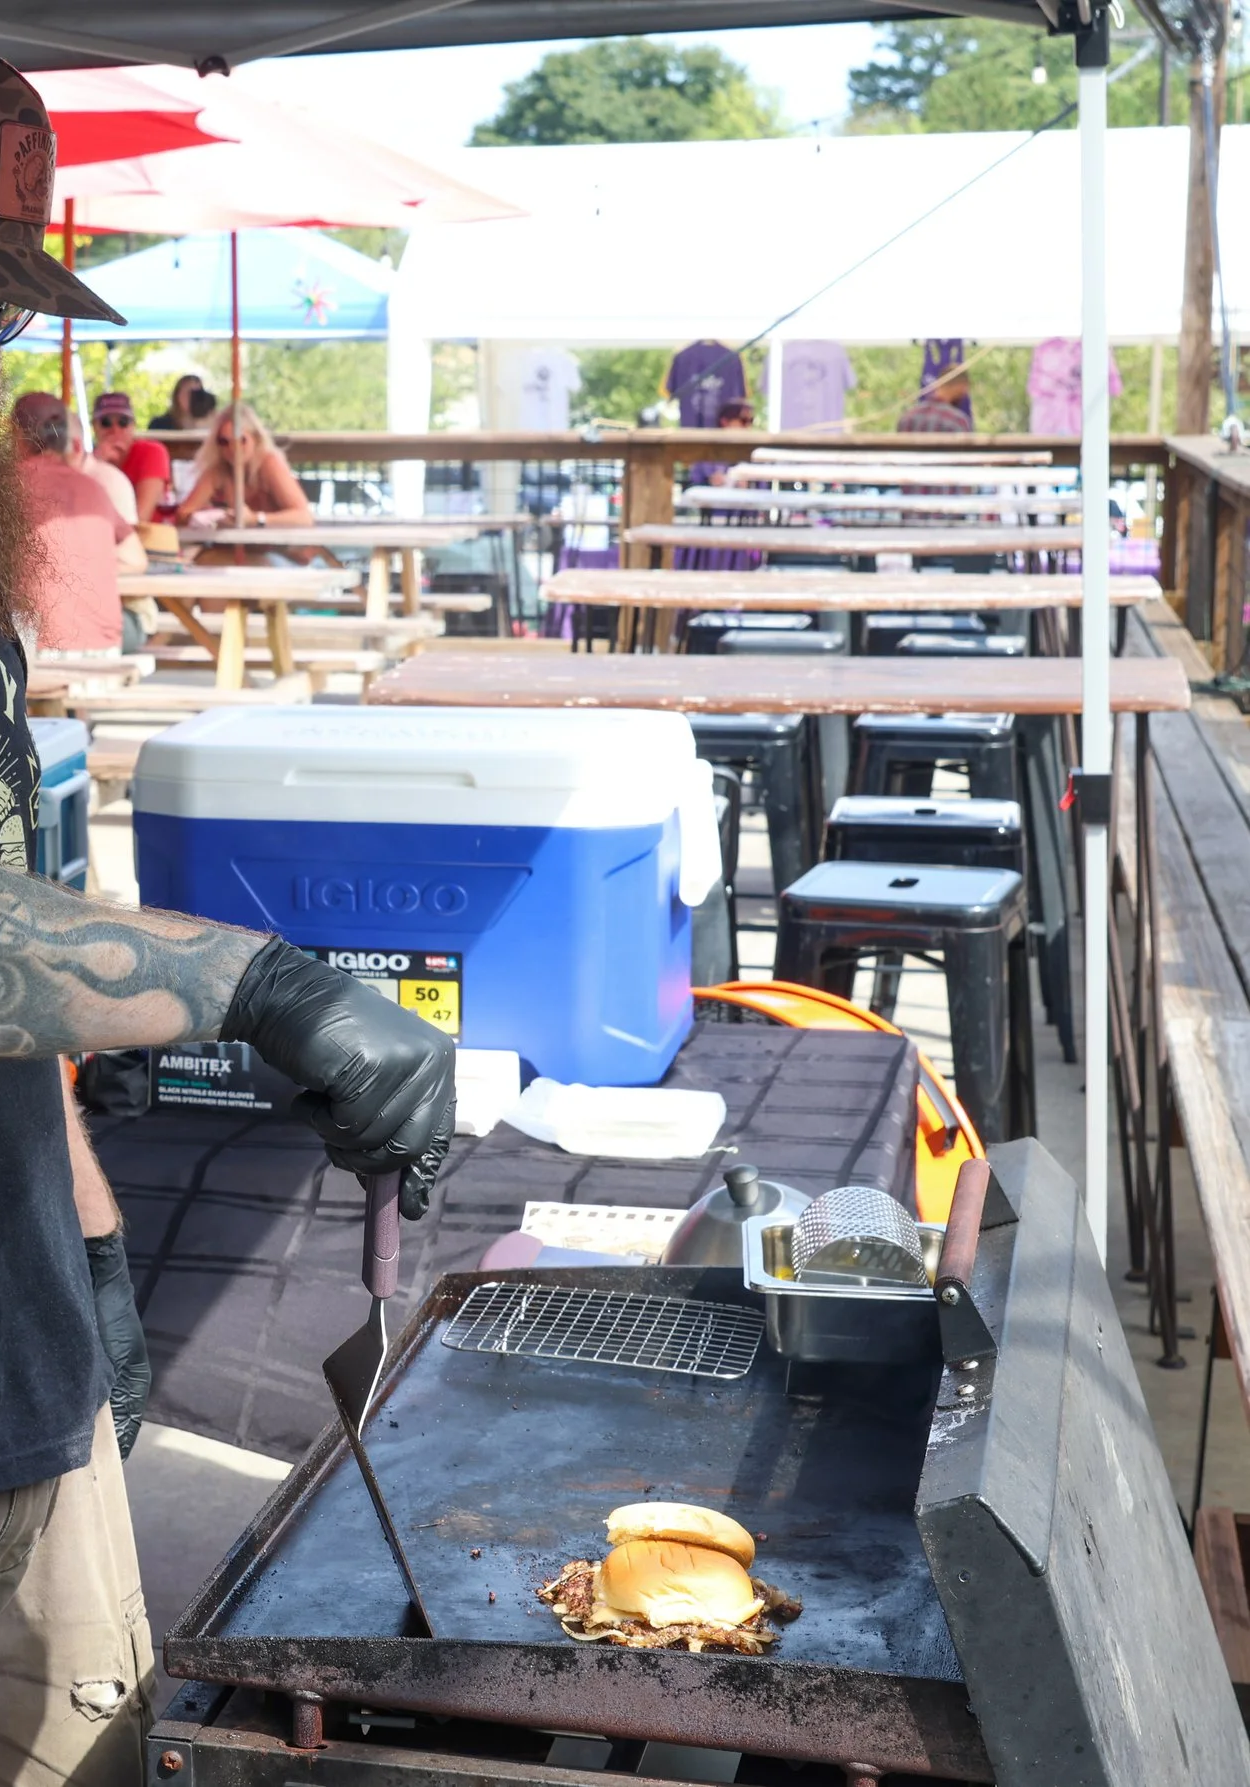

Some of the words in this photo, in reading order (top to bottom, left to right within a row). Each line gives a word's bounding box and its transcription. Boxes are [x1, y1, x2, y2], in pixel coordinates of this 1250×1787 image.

[292, 875, 469, 916] IGLOO
[328, 951, 411, 972] IGLOO
[415, 987, 440, 1002] 50
[433, 1010, 452, 1021] 47
[159, 1054, 232, 1073] AMBITEX
[181, 1087, 207, 1097] NITRILE
[228, 1091, 255, 1100] GLOVES
